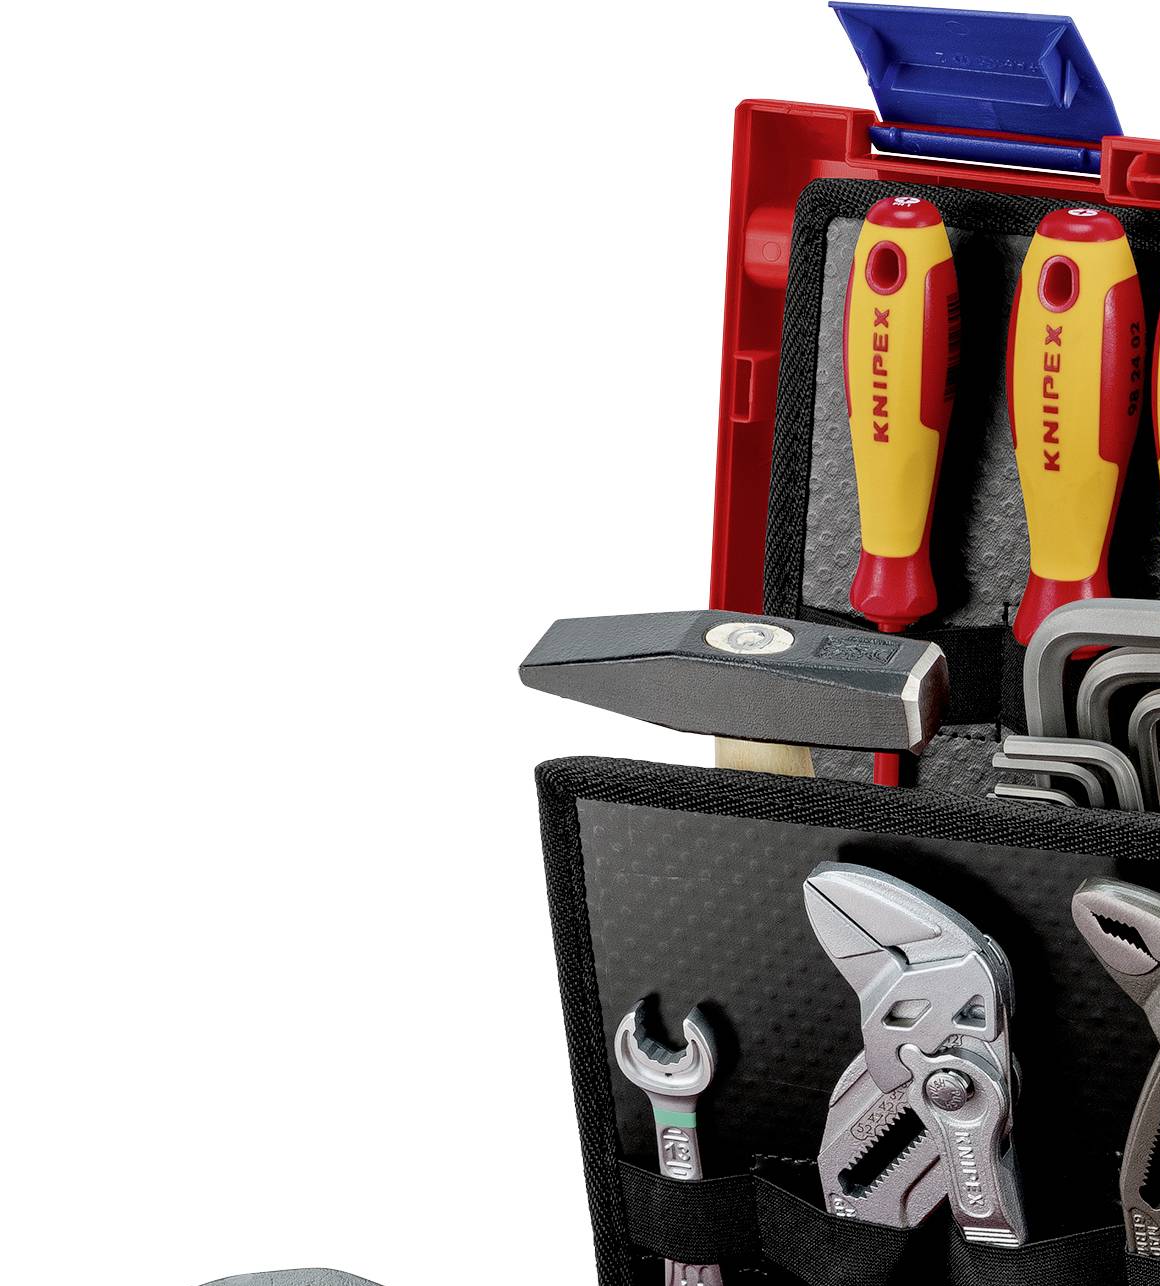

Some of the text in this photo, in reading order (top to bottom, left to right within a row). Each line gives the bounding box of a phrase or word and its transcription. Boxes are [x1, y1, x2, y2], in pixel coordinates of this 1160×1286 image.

[873, 308, 890, 443] KNIPEX
[1042, 325, 1063, 472] KNIPEX
[664, 1141, 691, 1161] 13
[856, 1122, 873, 1135] 52
[955, 1131, 985, 1206] KNIPEX
